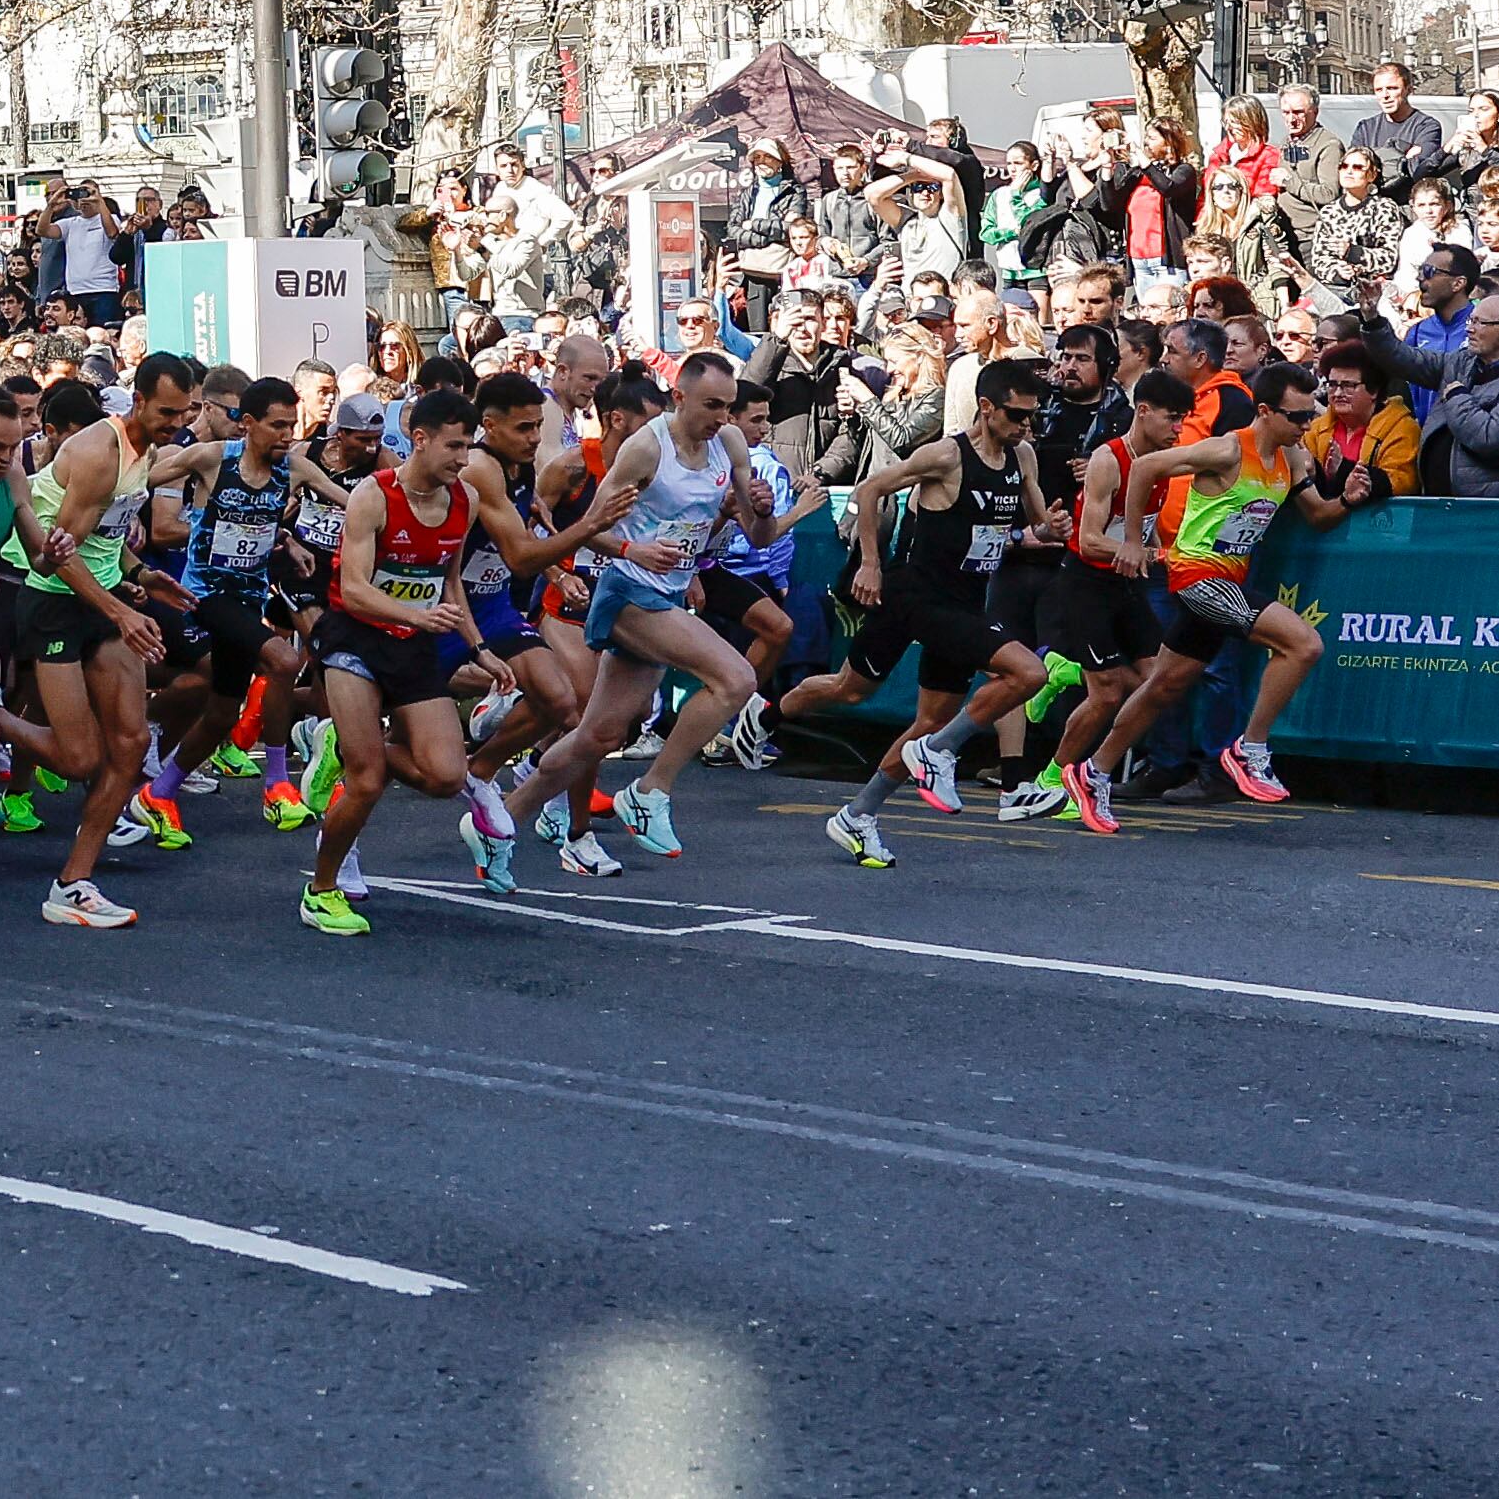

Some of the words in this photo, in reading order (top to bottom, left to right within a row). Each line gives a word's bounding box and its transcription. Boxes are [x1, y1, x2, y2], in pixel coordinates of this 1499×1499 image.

[305, 269, 347, 297] BM
[311, 515, 342, 535] 212
[236, 540, 259, 556] 82
[379, 578, 436, 600] 4700
[1338, 612, 1462, 646] RURAL
[46, 641, 64, 655] NB
[1337, 654, 1399, 670] GIZARTE
[1403, 657, 1469, 673] EKINTZA
